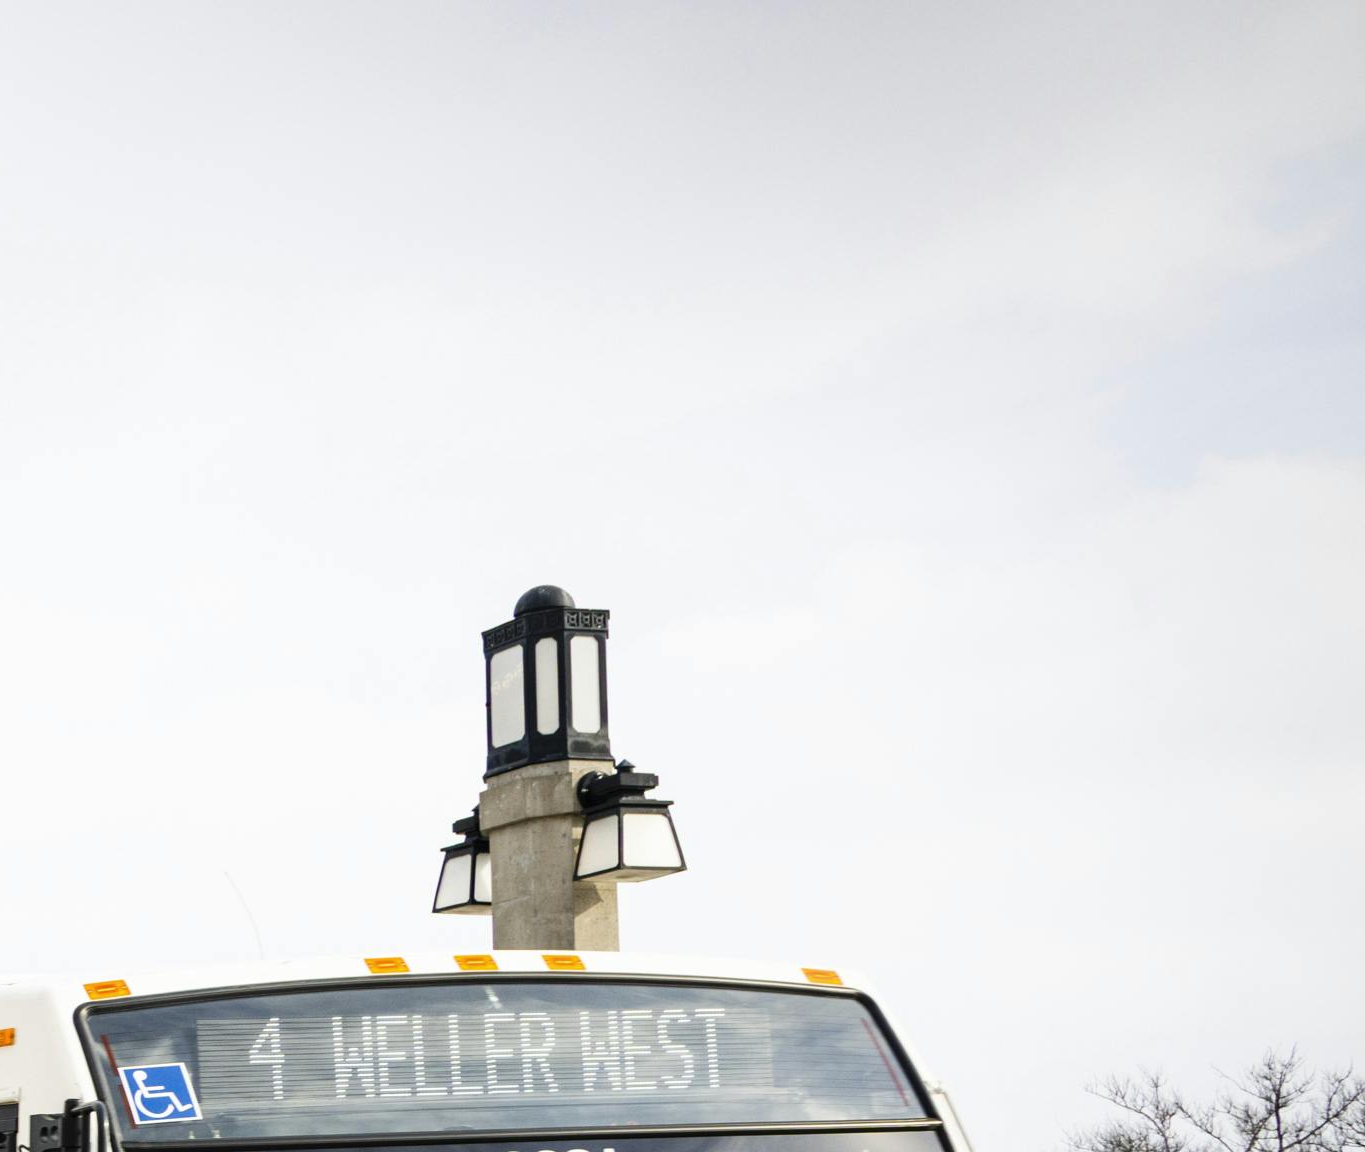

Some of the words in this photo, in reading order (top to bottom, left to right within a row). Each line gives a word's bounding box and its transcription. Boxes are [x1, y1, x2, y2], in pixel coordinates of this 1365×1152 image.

[249, 1017, 285, 1100] 4
[332, 1012, 559, 1098] WELLER
[580, 1008, 726, 1091] WEST
